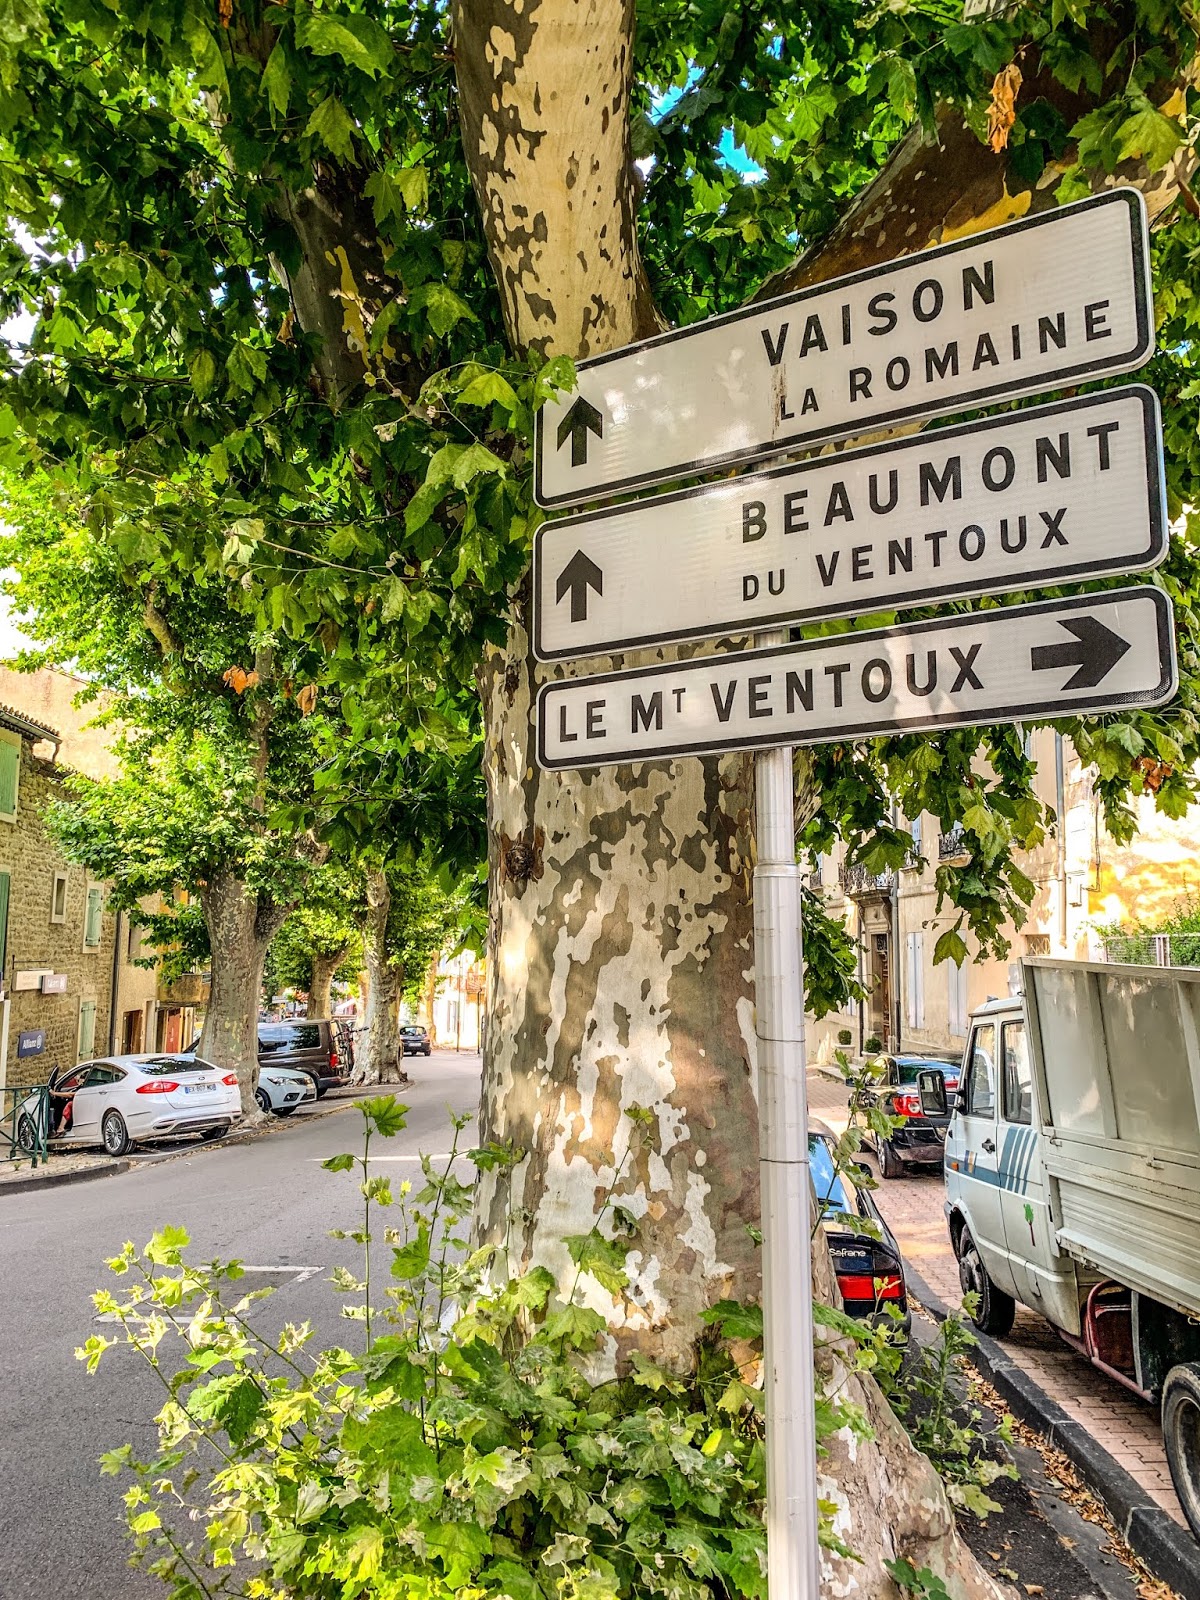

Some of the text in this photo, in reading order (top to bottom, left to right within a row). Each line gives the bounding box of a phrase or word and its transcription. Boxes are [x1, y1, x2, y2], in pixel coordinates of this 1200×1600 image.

[760, 259, 995, 367] VAISON
[779, 299, 1112, 421] LA ROMAINE
[742, 421, 1120, 544] BEAUMONT
[742, 507, 1070, 602] DU VENTOUX
[559, 699, 607, 743] LE
[709, 643, 985, 723] VENTOUX
[829, 1248, 866, 1257] Safrane
